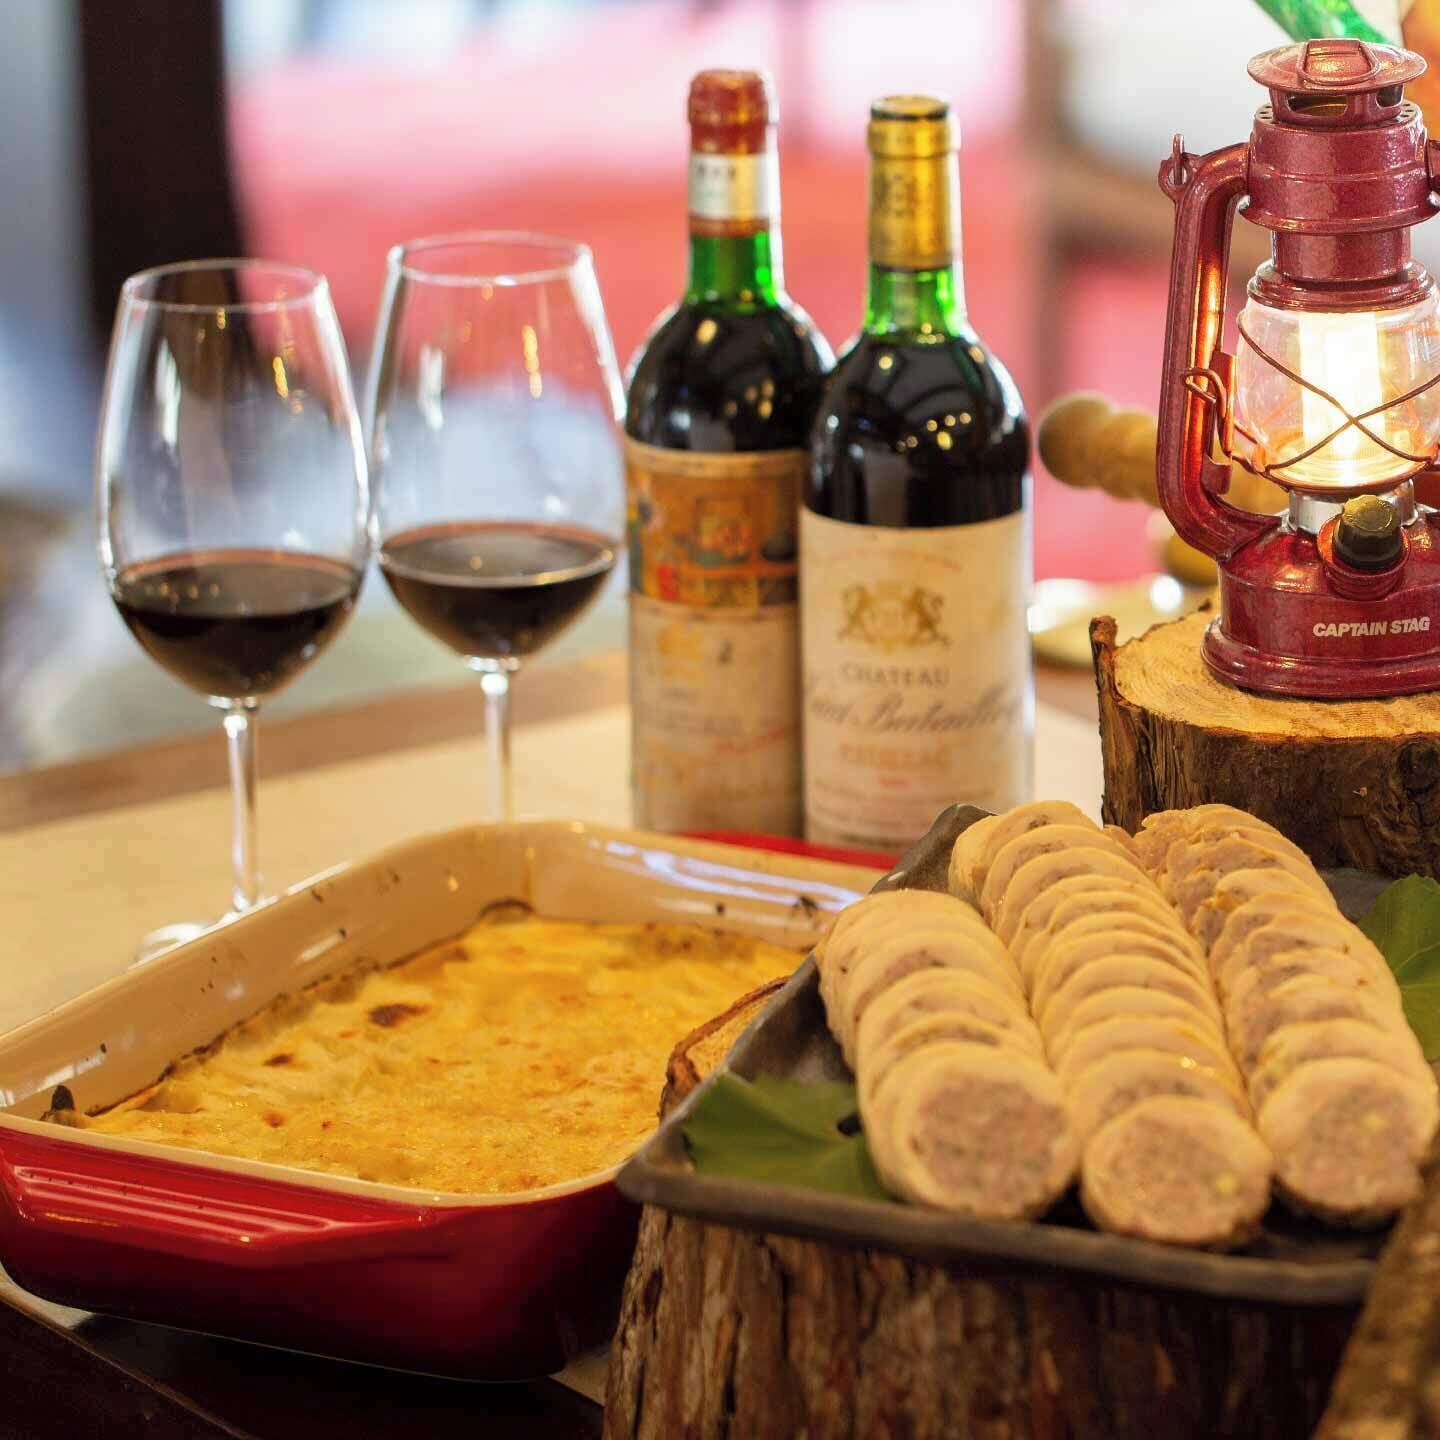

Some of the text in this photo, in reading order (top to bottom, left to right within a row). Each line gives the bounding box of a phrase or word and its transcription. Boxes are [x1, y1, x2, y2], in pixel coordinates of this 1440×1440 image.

[1312, 616, 1431, 637] CAPTAIN STAG
[839, 662, 950, 689] CHATEAU
